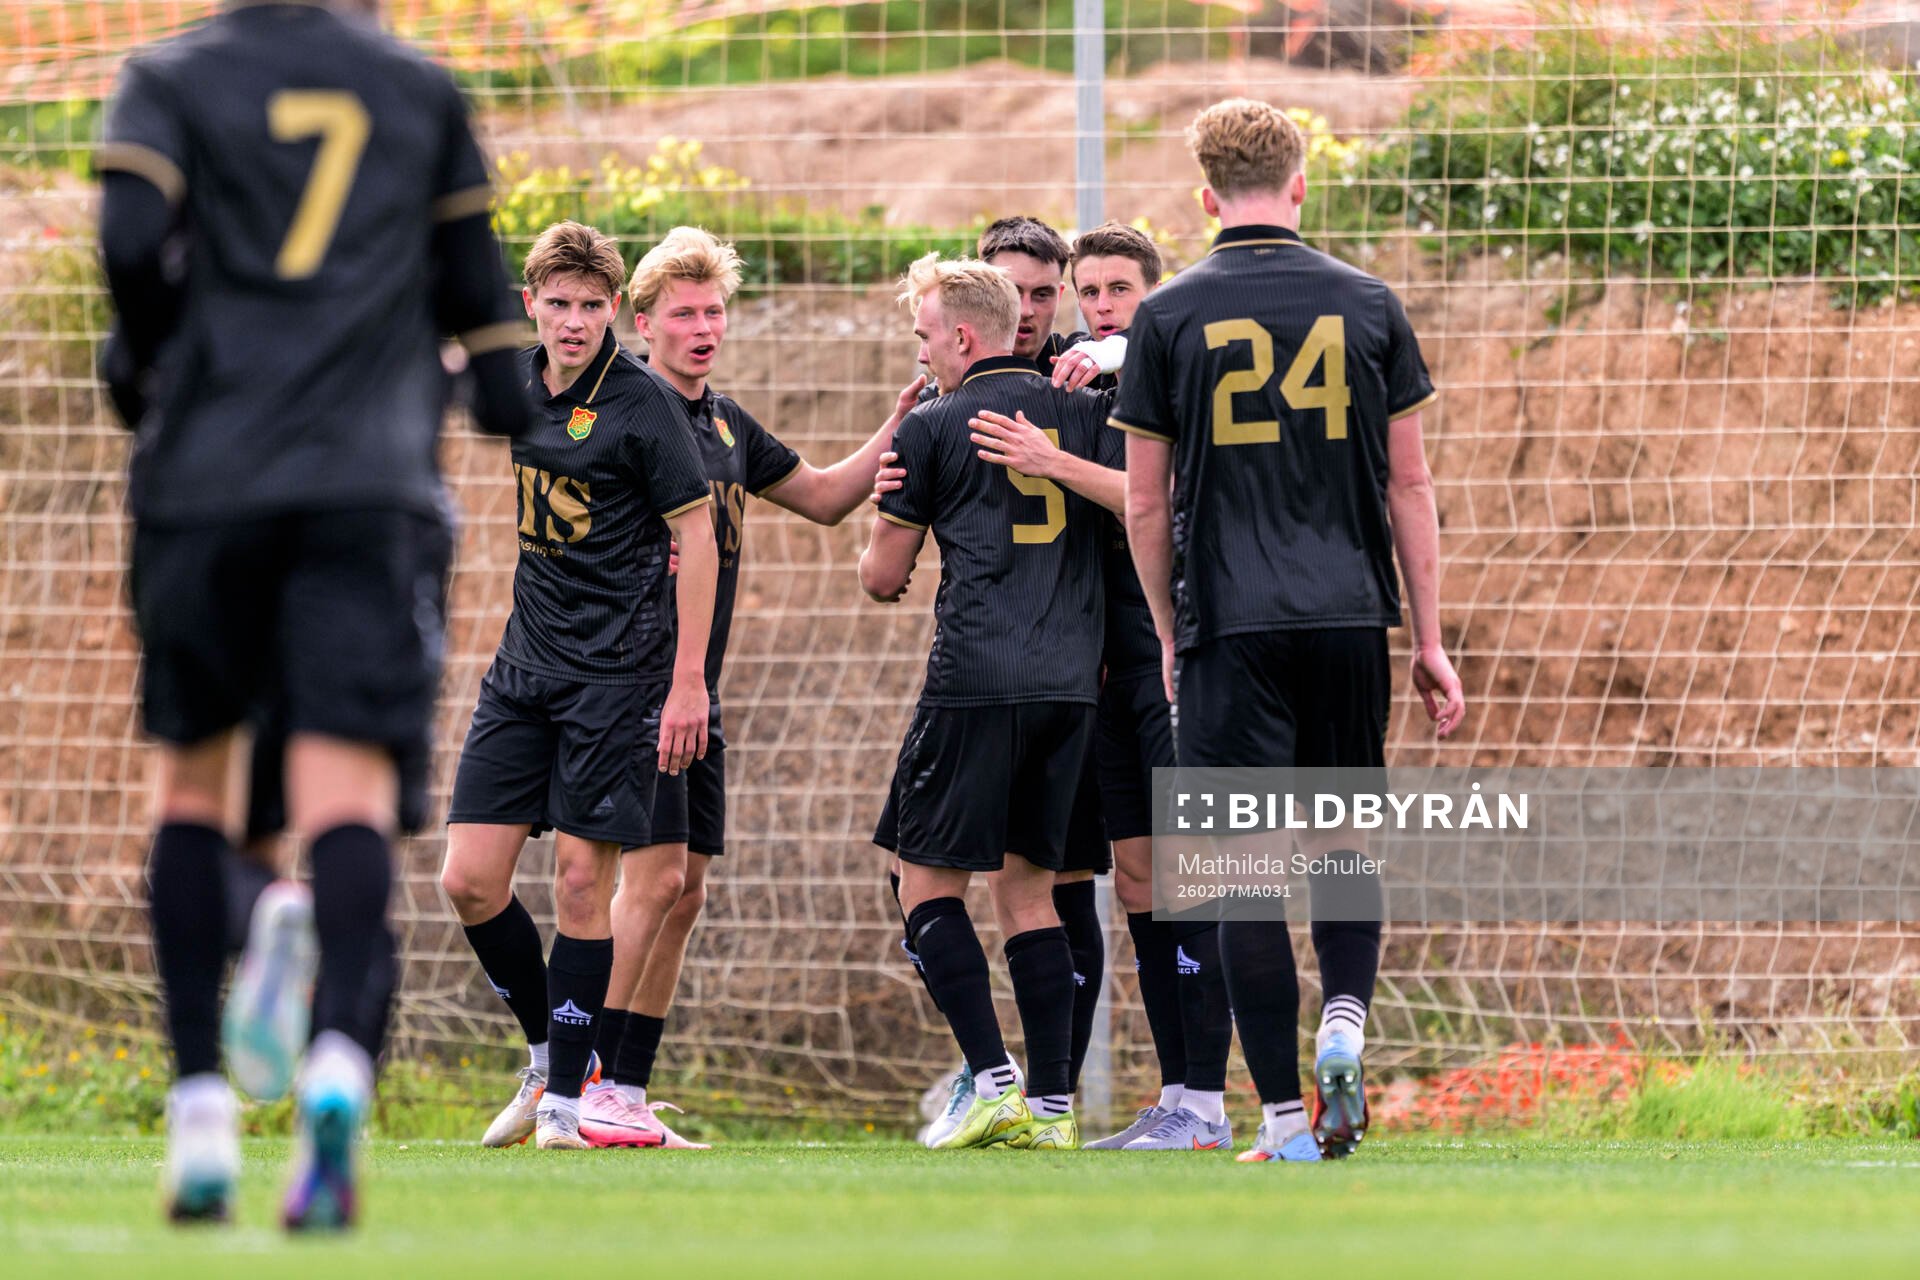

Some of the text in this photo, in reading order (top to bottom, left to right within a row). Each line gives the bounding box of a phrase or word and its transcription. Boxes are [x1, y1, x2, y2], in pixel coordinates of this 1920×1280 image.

[267, 89, 370, 280] 7
[1203, 315, 1352, 446] 24
[553, 1014, 591, 1026] SELECT
